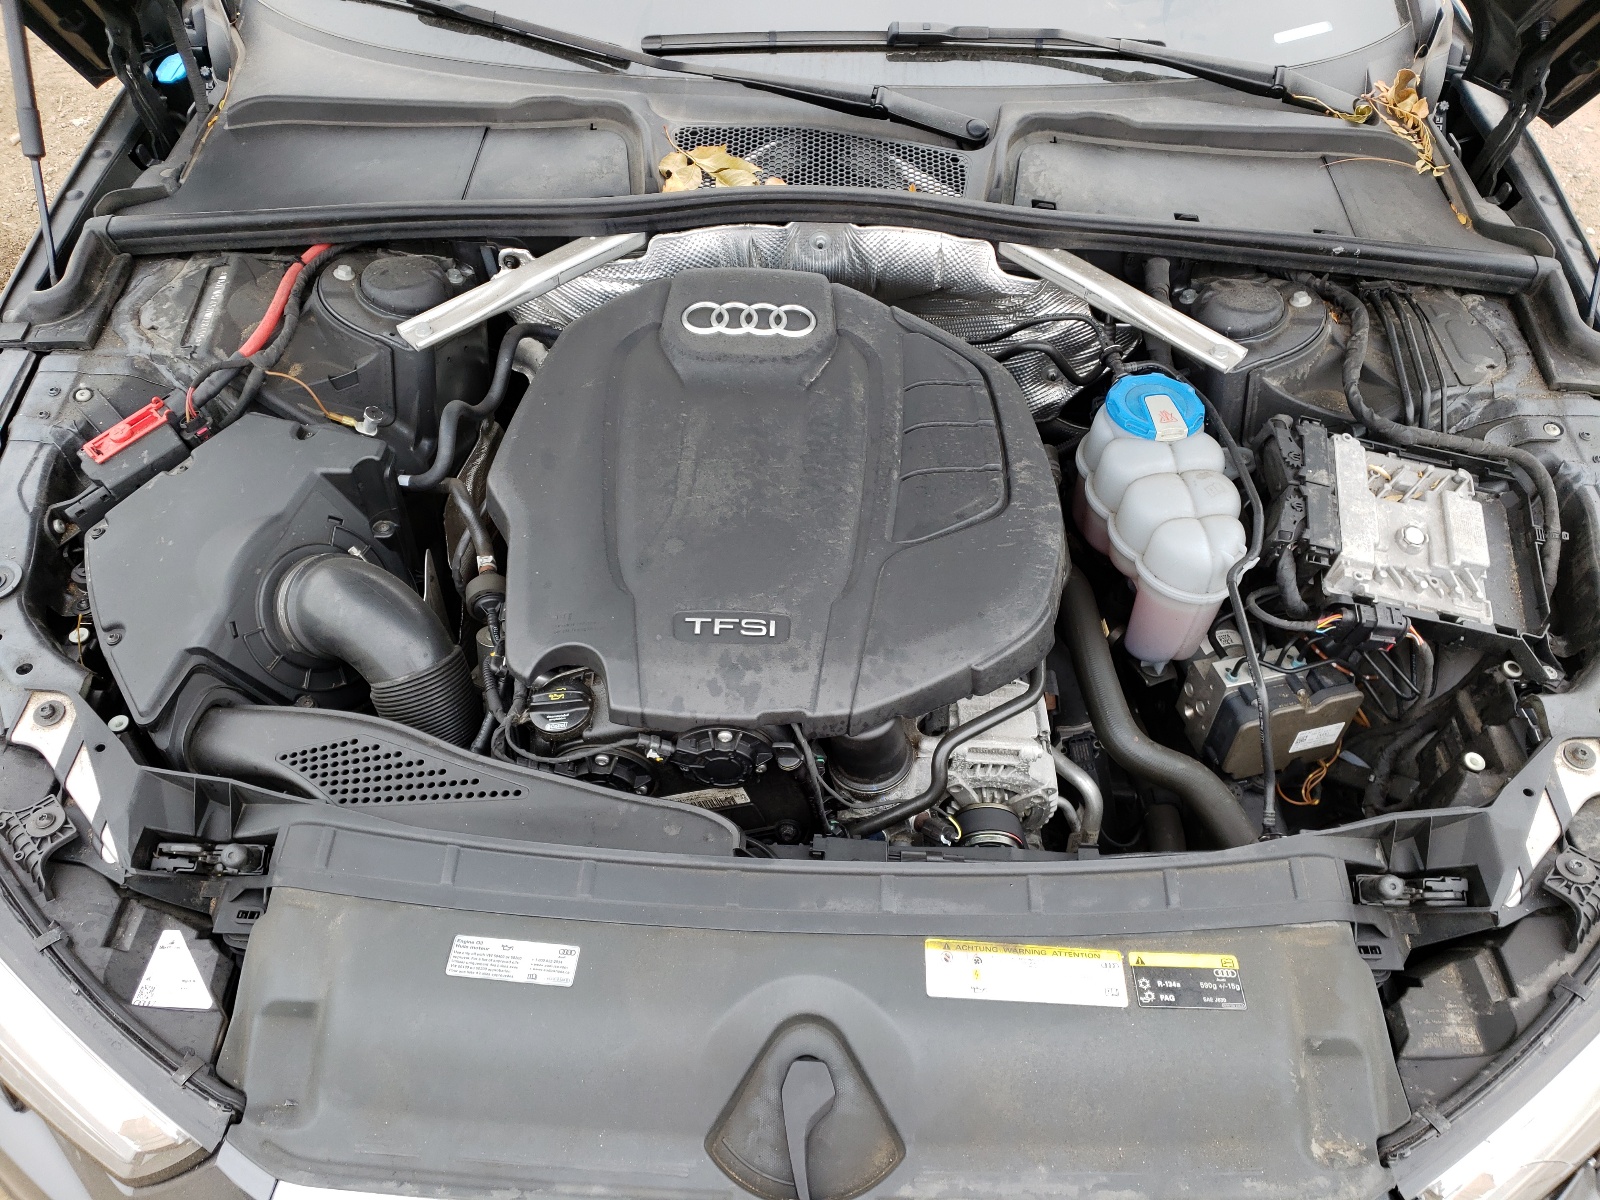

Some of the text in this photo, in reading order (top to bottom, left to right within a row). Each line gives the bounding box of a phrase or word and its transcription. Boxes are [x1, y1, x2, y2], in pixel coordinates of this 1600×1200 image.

[685, 617, 776, 637] TFSI
[955, 944, 1101, 959] ACHTUNG WARNING ATTENTION
[1157, 980, 1181, 988] R-134a
[1160, 994, 1176, 1002] PAG
